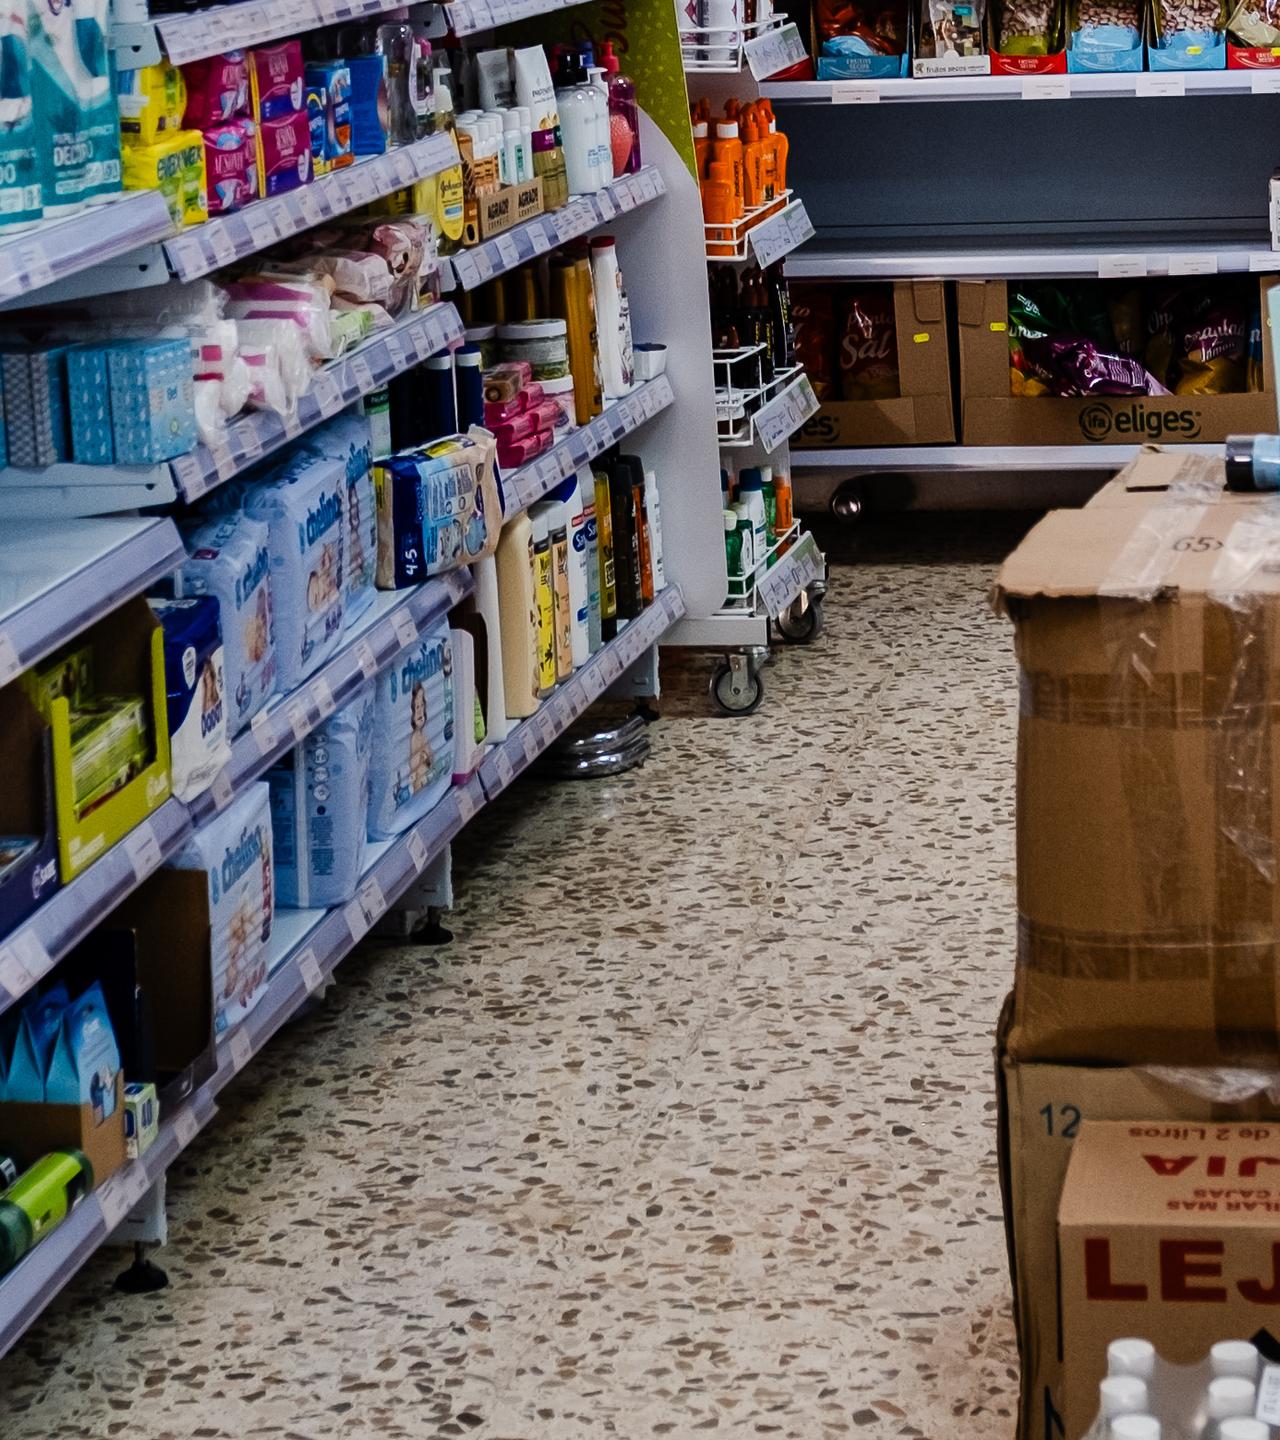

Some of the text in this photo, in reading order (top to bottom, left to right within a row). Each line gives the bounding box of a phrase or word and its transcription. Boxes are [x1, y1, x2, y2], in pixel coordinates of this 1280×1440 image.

[1117, 404, 1197, 438] eliges
[404, 548, 418, 577] 4-5
[1038, 1104, 1083, 1139] 12
[1127, 1124, 1208, 1142] Litros
[1217, 1127, 1232, 1141] 2
[1238, 1125, 1270, 1142] de
[1192, 1187, 1269, 1200] CAJAS
[1166, 1199, 1218, 1213] MAS
